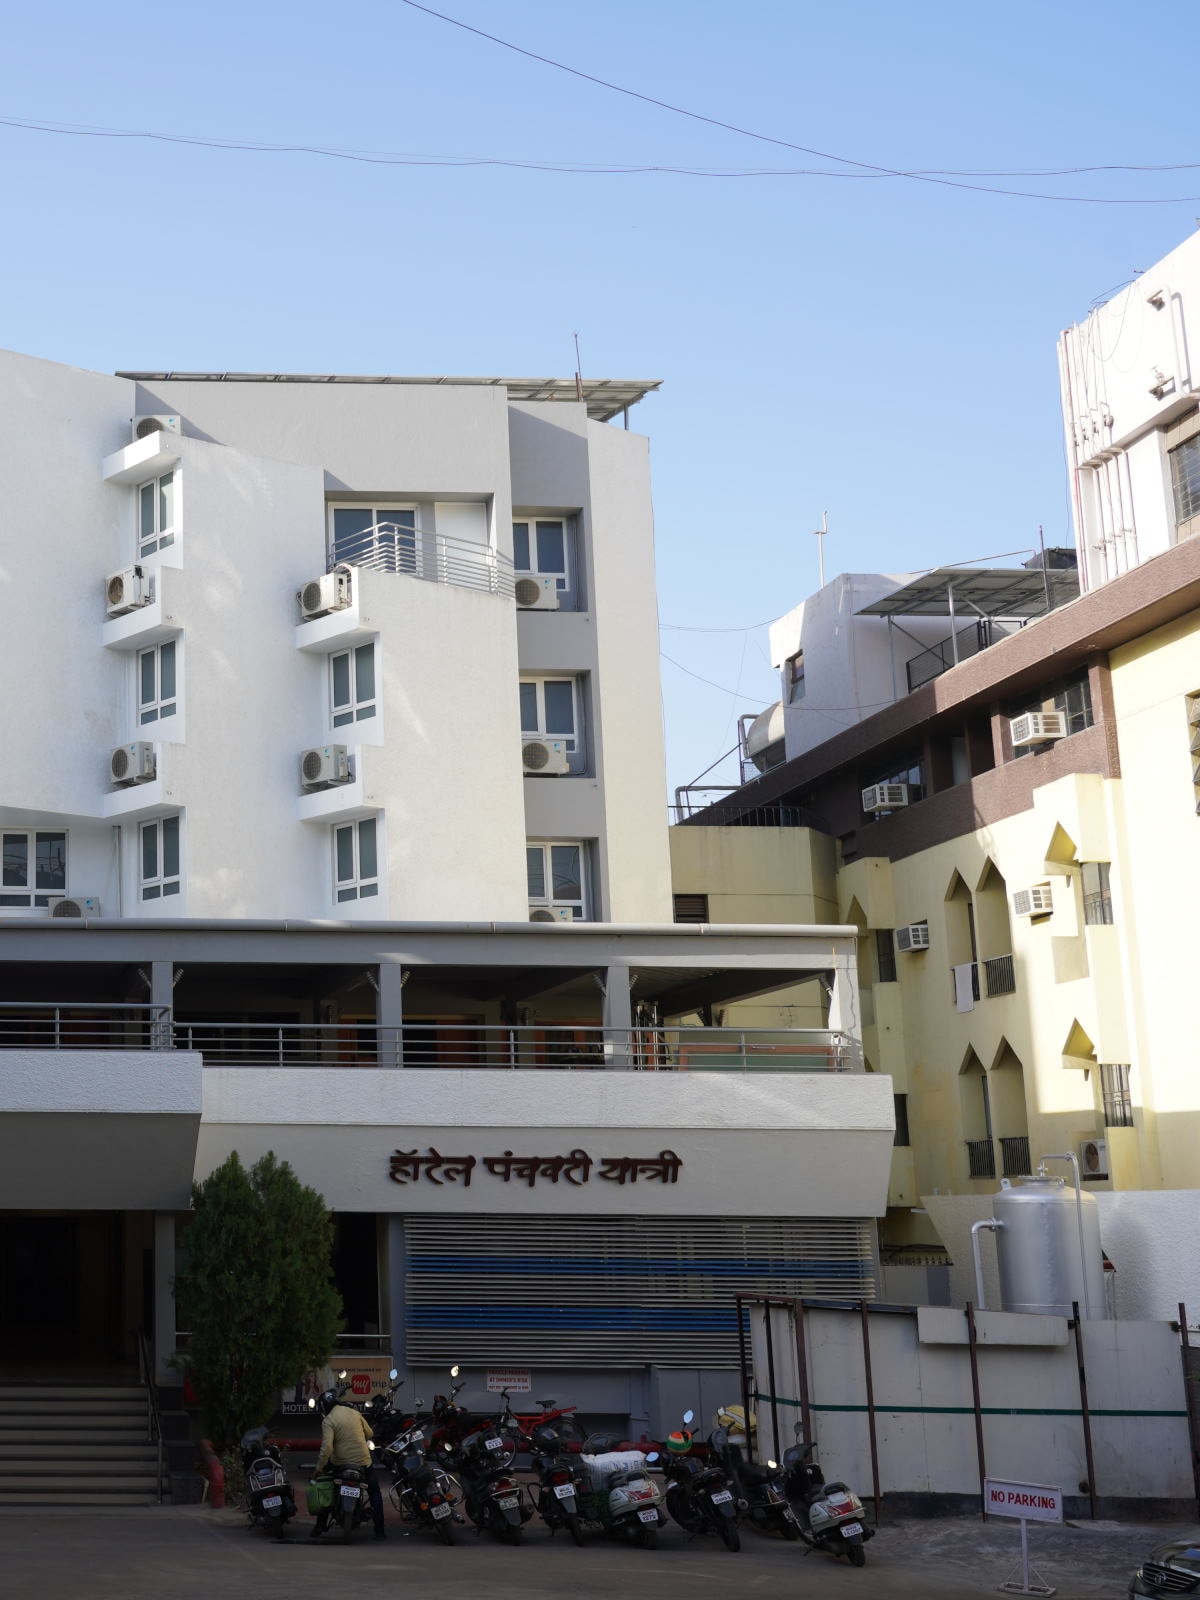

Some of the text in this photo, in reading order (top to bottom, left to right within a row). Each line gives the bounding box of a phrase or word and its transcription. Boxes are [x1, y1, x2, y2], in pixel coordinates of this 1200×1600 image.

[390, 1147, 683, 1188] हॉटेल पंचवटी यात्री
[991, 1490, 1056, 1509] NO PARKING
